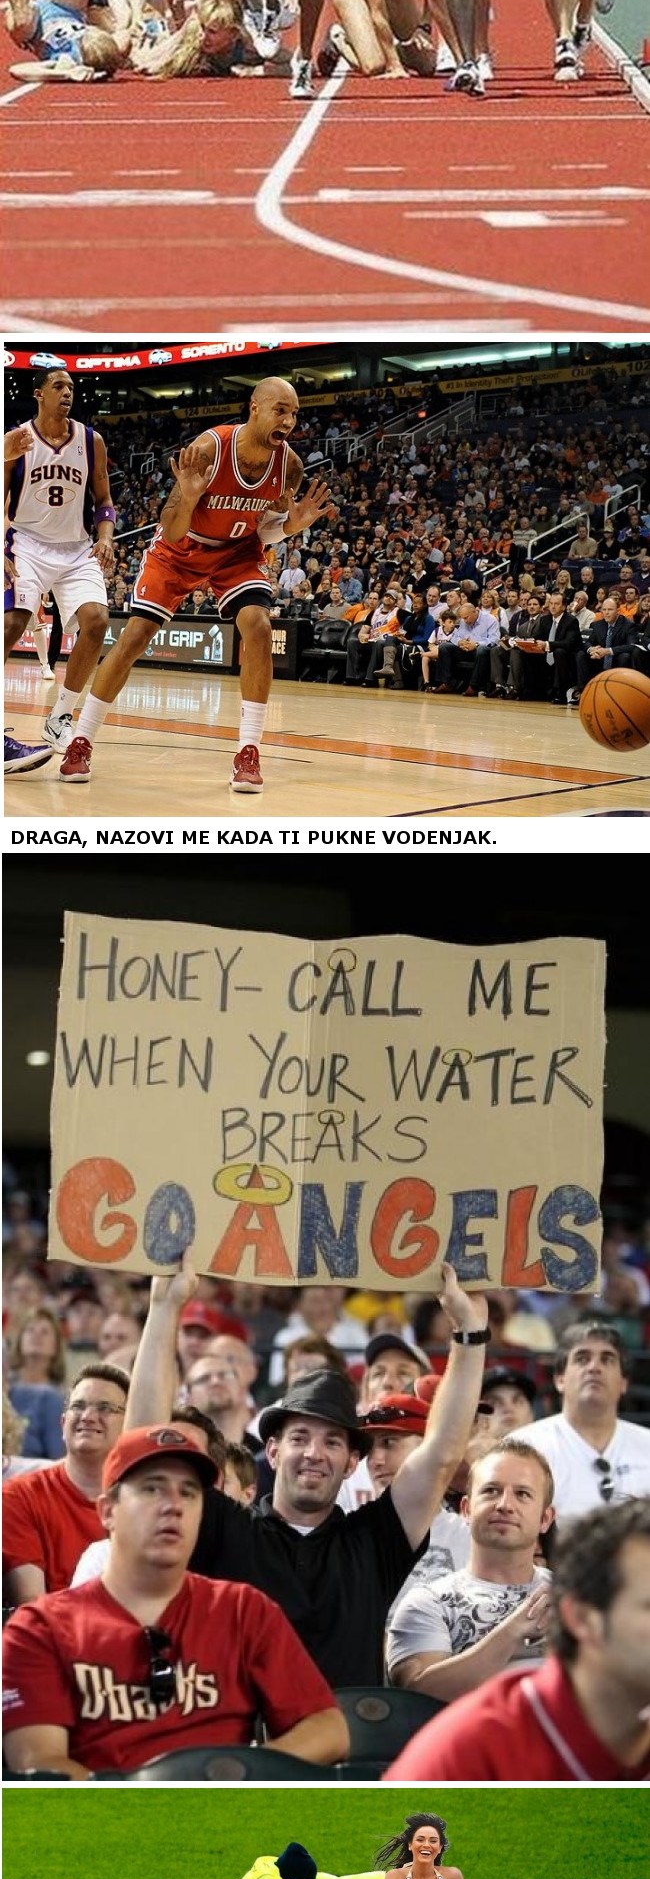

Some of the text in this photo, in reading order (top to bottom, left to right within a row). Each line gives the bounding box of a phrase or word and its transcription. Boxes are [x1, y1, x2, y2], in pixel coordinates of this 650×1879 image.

[76, 342, 246, 369] OPTIMA SORENTO
[30, 463, 83, 486] SUNS
[47, 485, 64, 507] 8
[229, 521, 247, 538] 0
[169, 630, 203, 648] GRIP
[271, 629, 287, 642] OUR
[271, 642, 286, 655] ACE
[288, 954, 423, 1016] CALL
[467, 958, 558, 1021] ME
[60, 1031, 593, 1108] WHEN YOUR WATER
[221, 1107, 429, 1164] BREAKS
[56, 1156, 603, 1292] GO ANGELS
